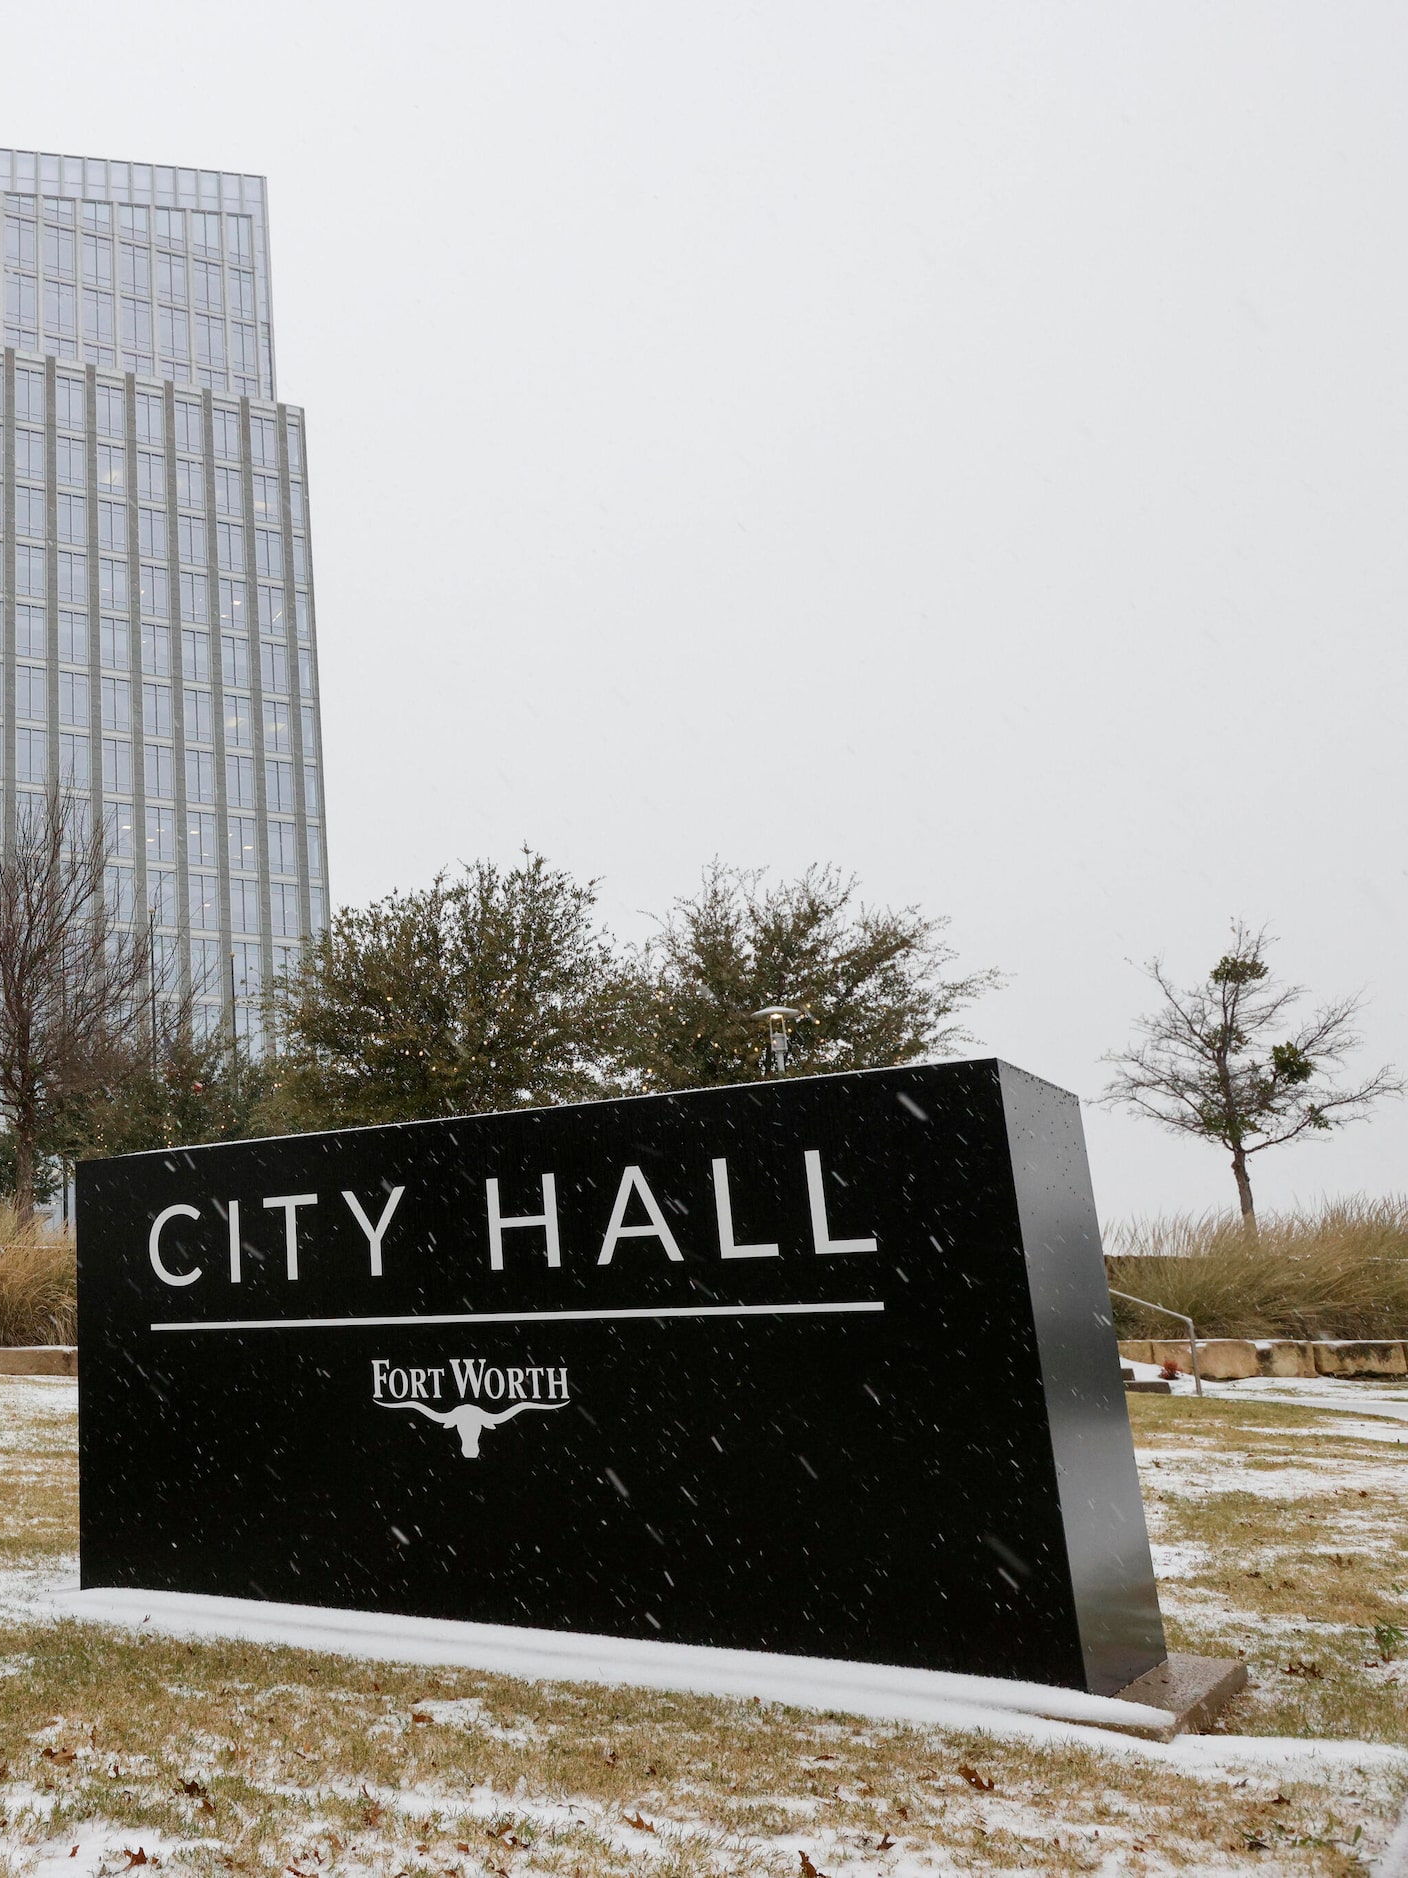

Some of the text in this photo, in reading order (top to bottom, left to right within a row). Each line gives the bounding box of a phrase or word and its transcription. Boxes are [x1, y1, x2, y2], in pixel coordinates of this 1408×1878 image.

[148, 1149, 878, 1287] CITY HALL
[371, 1358, 570, 1400] FORT WORTH
